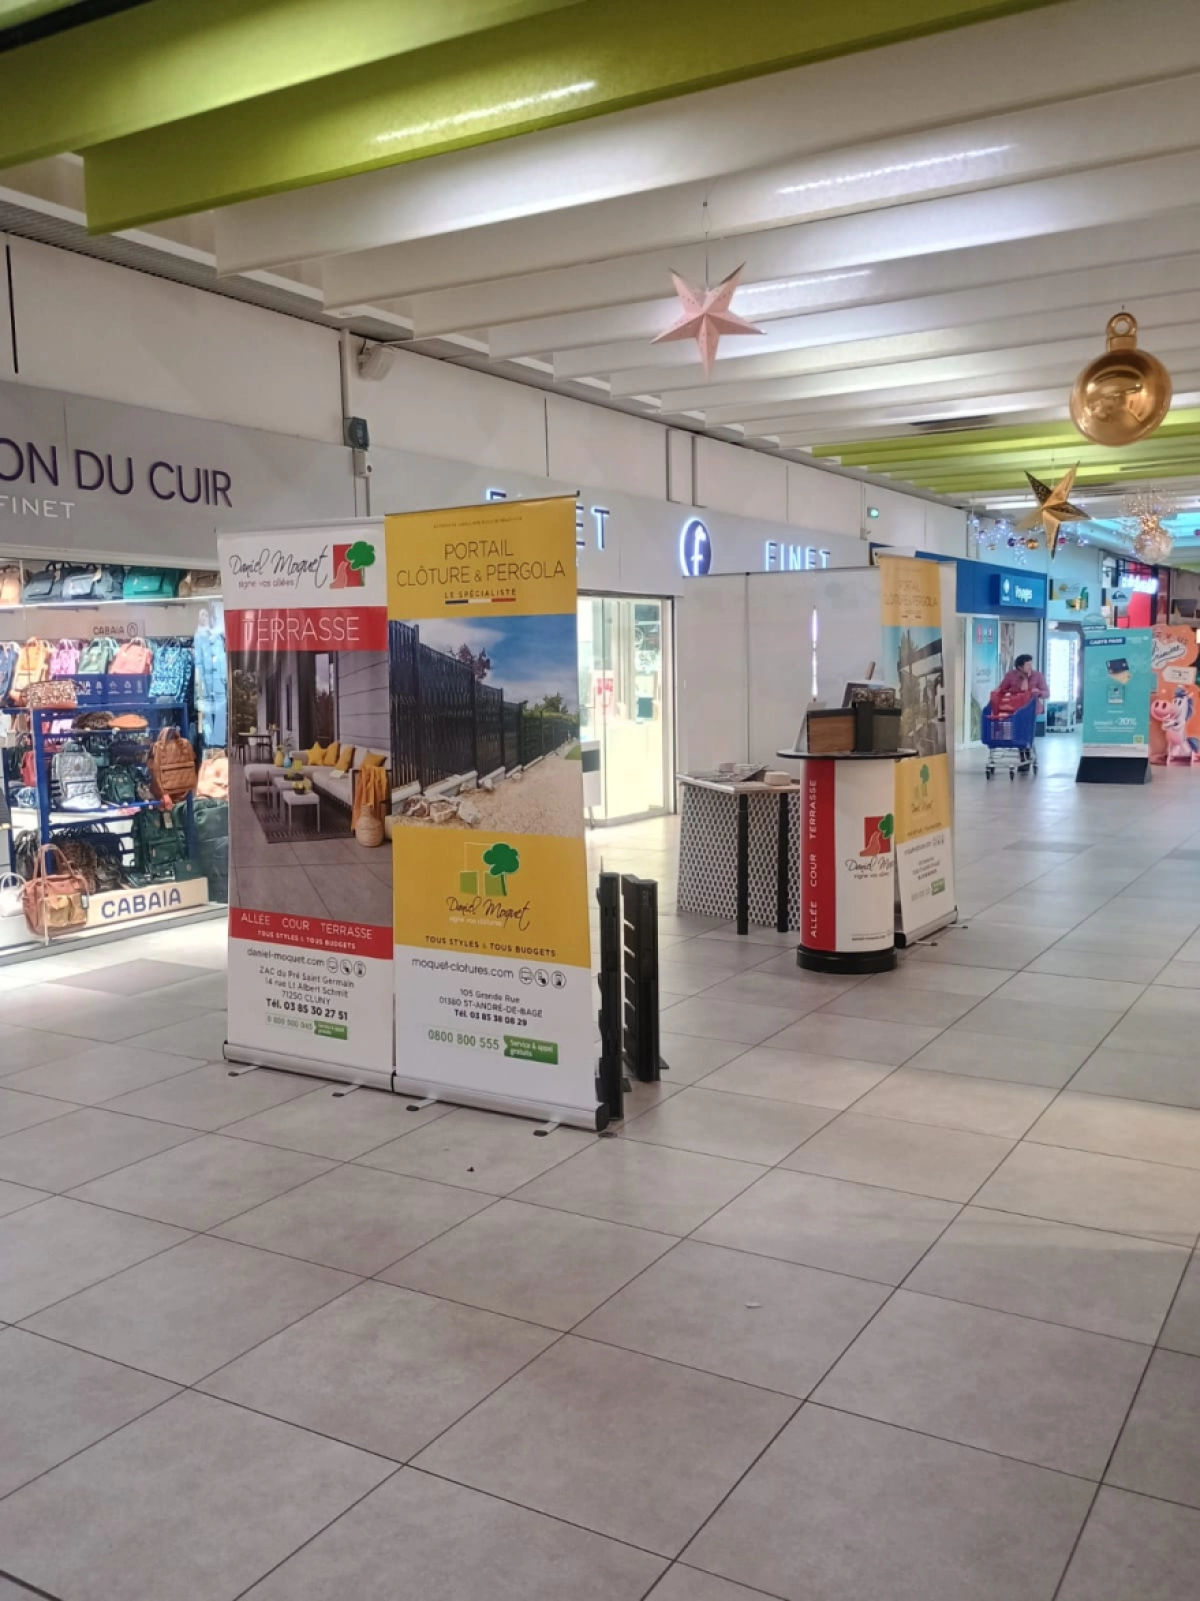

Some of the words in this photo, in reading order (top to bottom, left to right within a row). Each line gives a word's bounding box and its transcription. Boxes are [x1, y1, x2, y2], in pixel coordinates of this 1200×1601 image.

[74, 448, 134, 495] DU
[149, 460, 233, 508] CUIR
[444, 539, 514, 561] PORTAIL
[765, 541, 831, 571] FINET
[229, 548, 270, 577] Daniel
[272, 544, 328, 588] Moquet
[396, 565, 471, 587] CLÔTURE
[474, 570, 482, 582] &
[486, 560, 566, 581] PERGOLA
[444, 591, 455, 599] LE
[458, 588, 517, 598] SPÉCIALISTE
[92, 625, 125, 636] CABAIA
[242, 616, 360, 641] TERRASSE
[809, 780, 817, 839] TERRASSE
[101, 888, 181, 919] CABAIA
[445, 896, 482, 916] Daniel
[483, 899, 531, 931] Moquet
[241, 913, 271, 926] ALLÉE
[281, 917, 310, 931] COUR
[320, 922, 373, 940] TERRASSE
[257, 930, 274, 938] TOUS
[275, 932, 299, 942] STYLES
[306, 937, 323, 945] TOUS
[324, 939, 356, 950] BUDGETS
[425, 935, 447, 944] TOUS
[449, 938, 480, 948] STYLES
[489, 943, 513, 952] TOUS
[515, 945, 557, 957] BUDGETS
[247, 947, 325, 967] daniel-moquet.com
[259, 965, 275, 975] ZAC
[276, 969, 286, 978] du
[288, 970, 300, 979] Pré
[302, 972, 320, 983] Saint
[322, 976, 355, 988] Germain
[274, 980, 286, 988] rue
[298, 982, 320, 993] Albert
[305, 993, 331, 1005] CLUNY
[475, 990, 503, 1001] Grande
[504, 994, 520, 1003] Rue
[266, 998, 281, 1008] Tél.
[283, 1001, 295, 1011] 03
[297, 1003, 308, 1013] 85
[310, 1005, 322, 1016] 30
[324, 1008, 335, 1018] 27
[338, 1010, 348, 1021] 51
[428, 1029, 453, 1043] 0800
[456, 1033, 476, 1047] 800
[479, 1038, 499, 1050] 555
